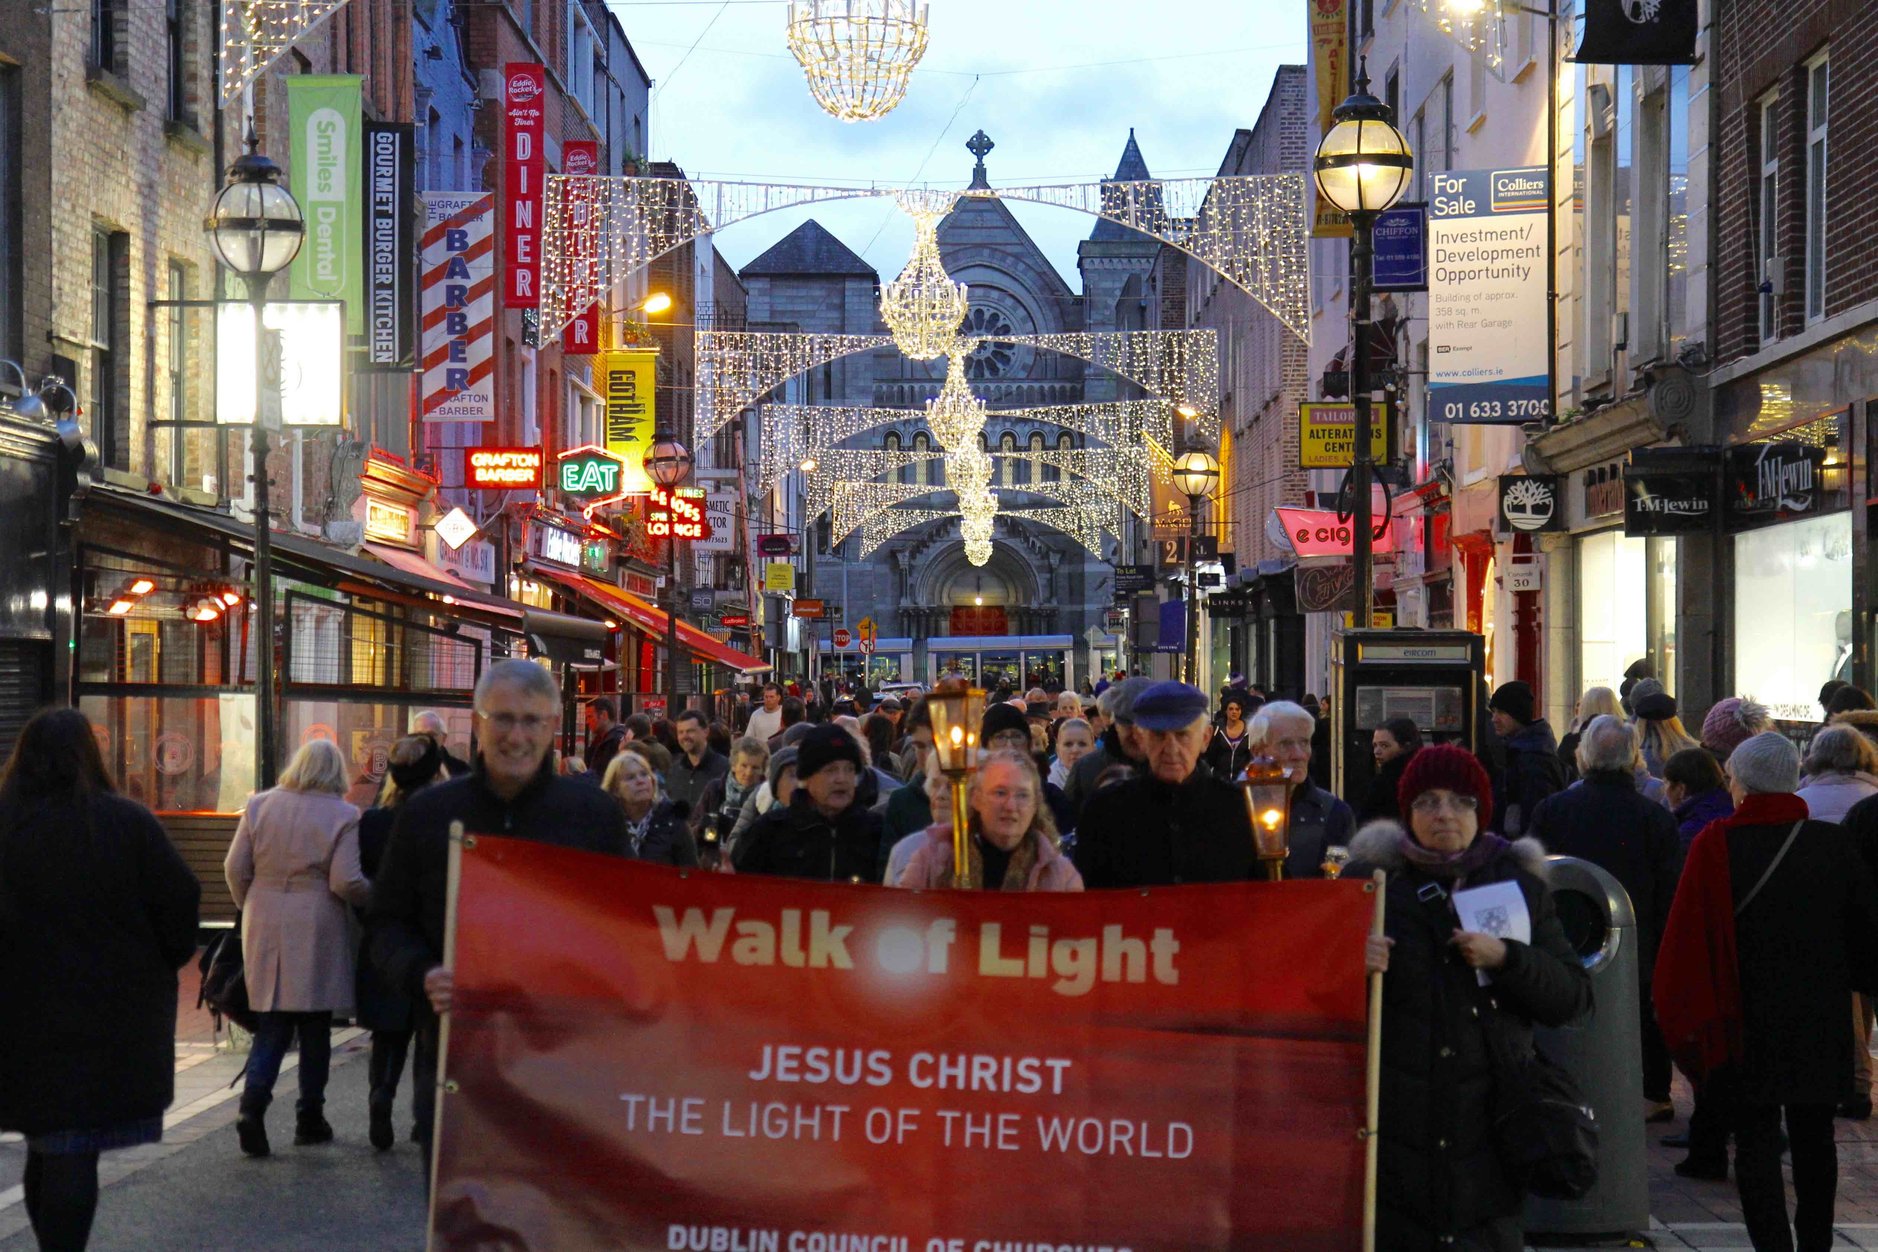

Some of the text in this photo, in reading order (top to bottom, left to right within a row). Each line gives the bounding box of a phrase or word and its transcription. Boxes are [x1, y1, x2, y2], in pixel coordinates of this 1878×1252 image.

[512, 79, 533, 87] Eddie
[508, 85, 542, 95] Rocket's
[508, 108, 528, 117] Ain't
[1433, 174, 1468, 195] For
[1497, 178, 1544, 192] Colliers
[316, 120, 338, 281] Smiles Dental
[1498, 190, 1544, 198] INTERNATIONAL
[1433, 195, 1476, 216] Sale
[515, 131, 533, 297] DINER
[1375, 226, 1419, 237] CHIFFON
[1435, 223, 1534, 245] Investment/
[375, 131, 395, 364] GOURMET BURGER KITCHEN
[1436, 244, 1541, 264] Development
[1435, 263, 1531, 285] Opportunity
[1435, 291, 1519, 304] Building of approx.
[444, 228, 471, 392] BARBER
[1435, 307, 1453, 317] 358
[1435, 318, 1513, 330] with Rear Garage
[1435, 367, 1504, 378] www.colliers.ie
[439, 406, 485, 416] BARBER
[608, 370, 647, 442] GOTHAM
[1444, 402, 1464, 418] 01
[1469, 401, 1502, 417] 633
[1315, 411, 1376, 422] TAILORG
[471, 454, 540, 467] GRAFTON
[475, 469, 535, 482] BARBER
[562, 461, 619, 492] EAT
[674, 488, 705, 499] WINES
[706, 500, 730, 512] SMETIC
[1165, 540, 1178, 563] 2
[1513, 579, 1530, 588] 30
[834, 634, 851, 642] STOP
[1403, 647, 1437, 657] eircom
[652, 904, 1181, 998] Walk of Light
[749, 1044, 1073, 1095] JESUS CHRIST
[619, 1093, 1195, 1160] THE LIGHT OF THE WORLD
[667, 1223, 780, 1252] DUBLIN
[788, 1230, 909, 1252] COUNCIL
